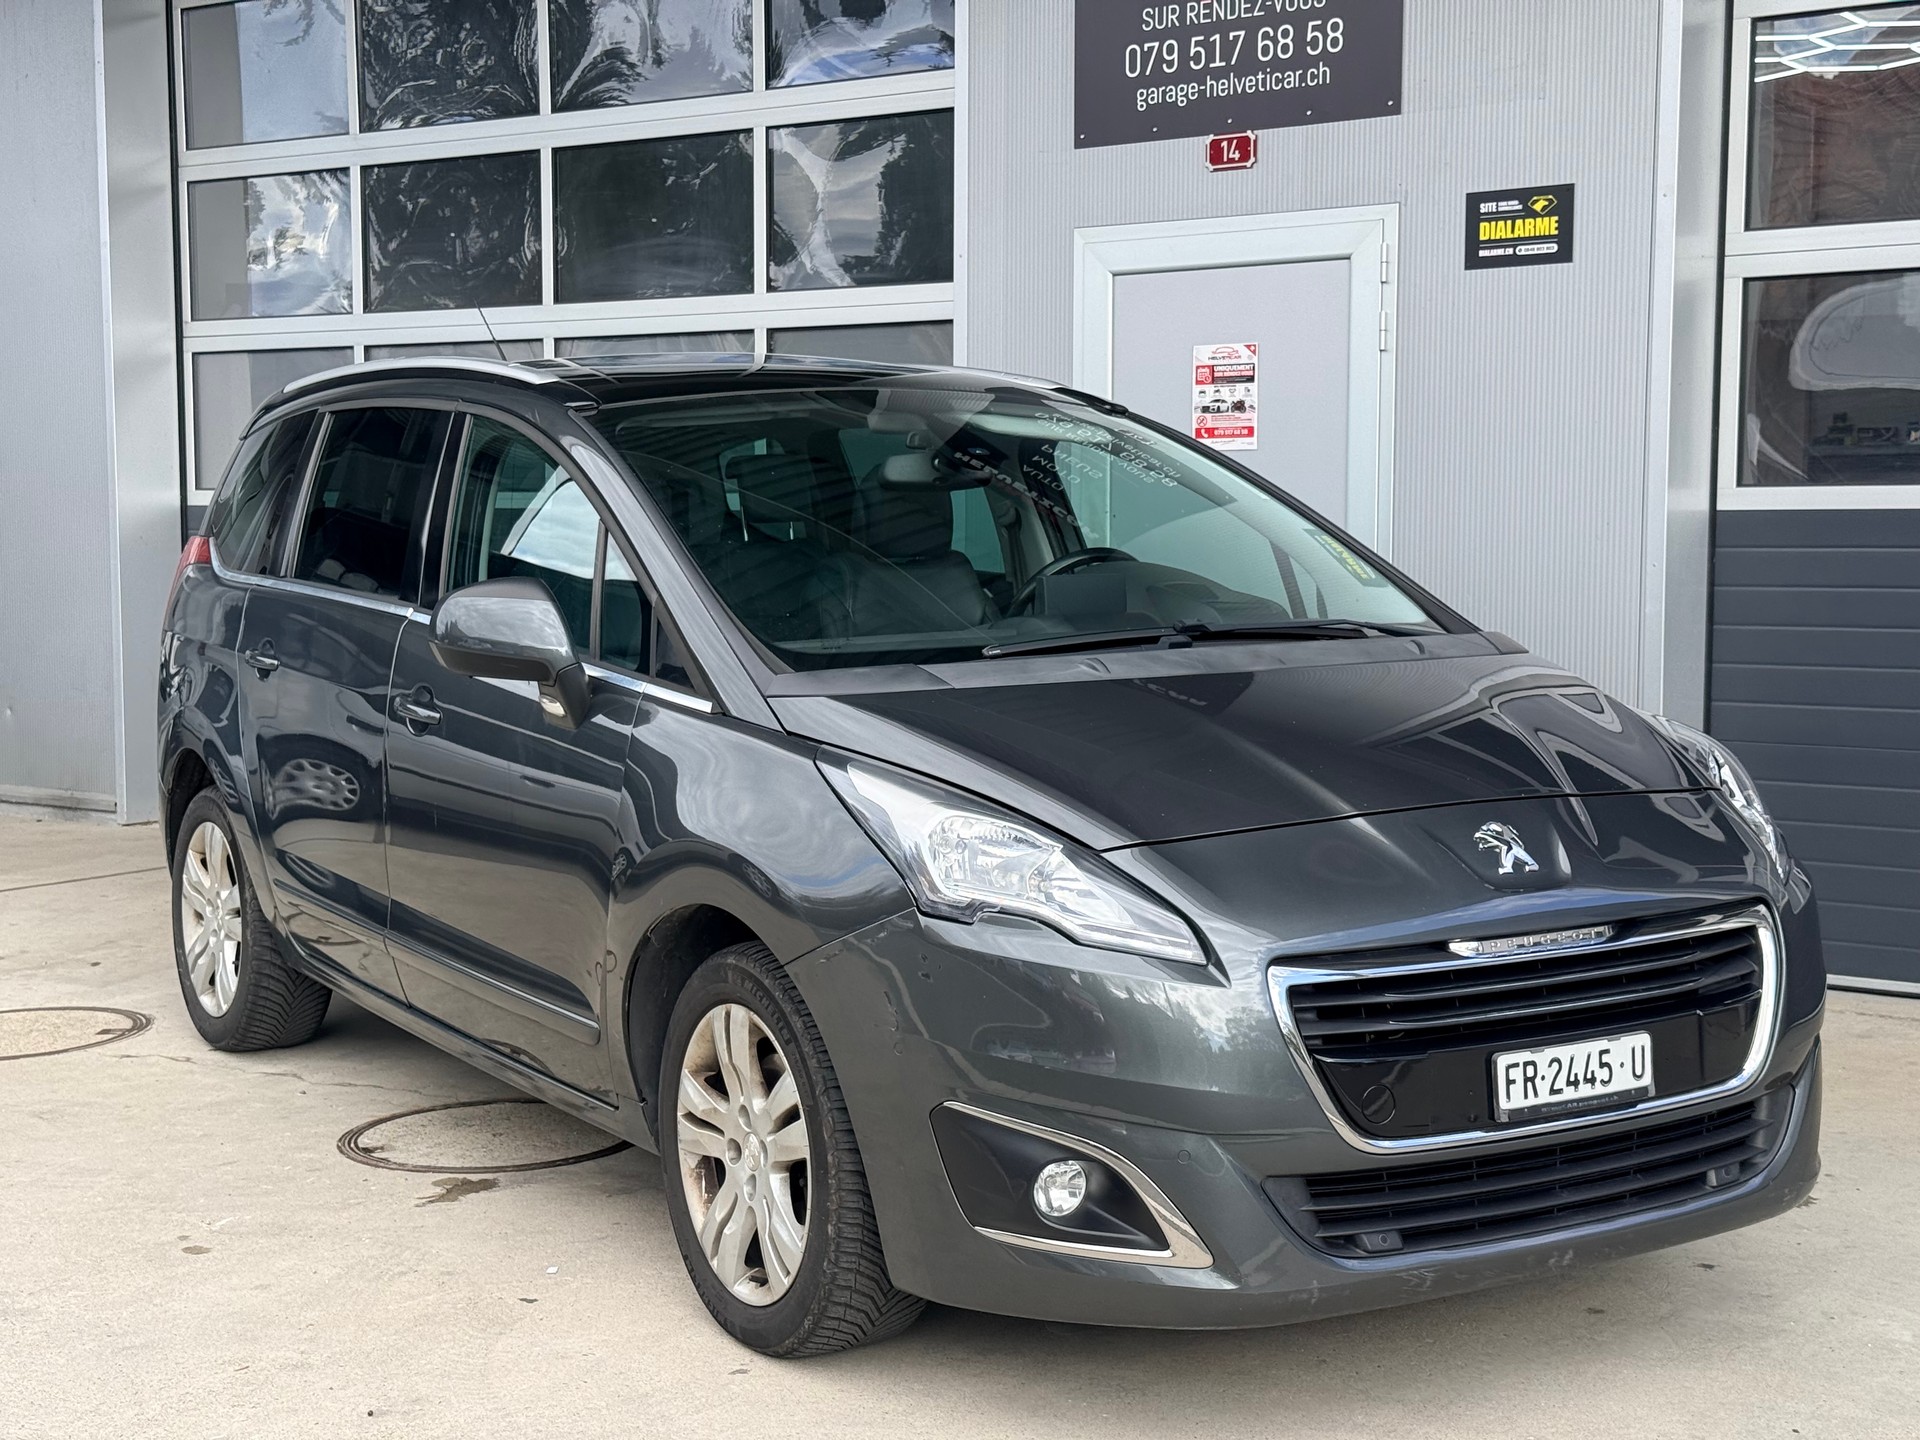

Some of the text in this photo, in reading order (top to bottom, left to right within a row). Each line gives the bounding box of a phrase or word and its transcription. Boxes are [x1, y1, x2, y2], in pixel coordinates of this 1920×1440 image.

[1141, 4, 1180, 31] SUR
[1124, 17, 1345, 78] 079 517 68 58
[1136, 62, 1331, 111] garage-helveticar.ch
[1219, 140, 1241, 162] 14
[1479, 202, 1497, 213] SITE
[1479, 216, 1559, 241] DIALARME
[1490, 929, 1597, 951] PEUGEOT
